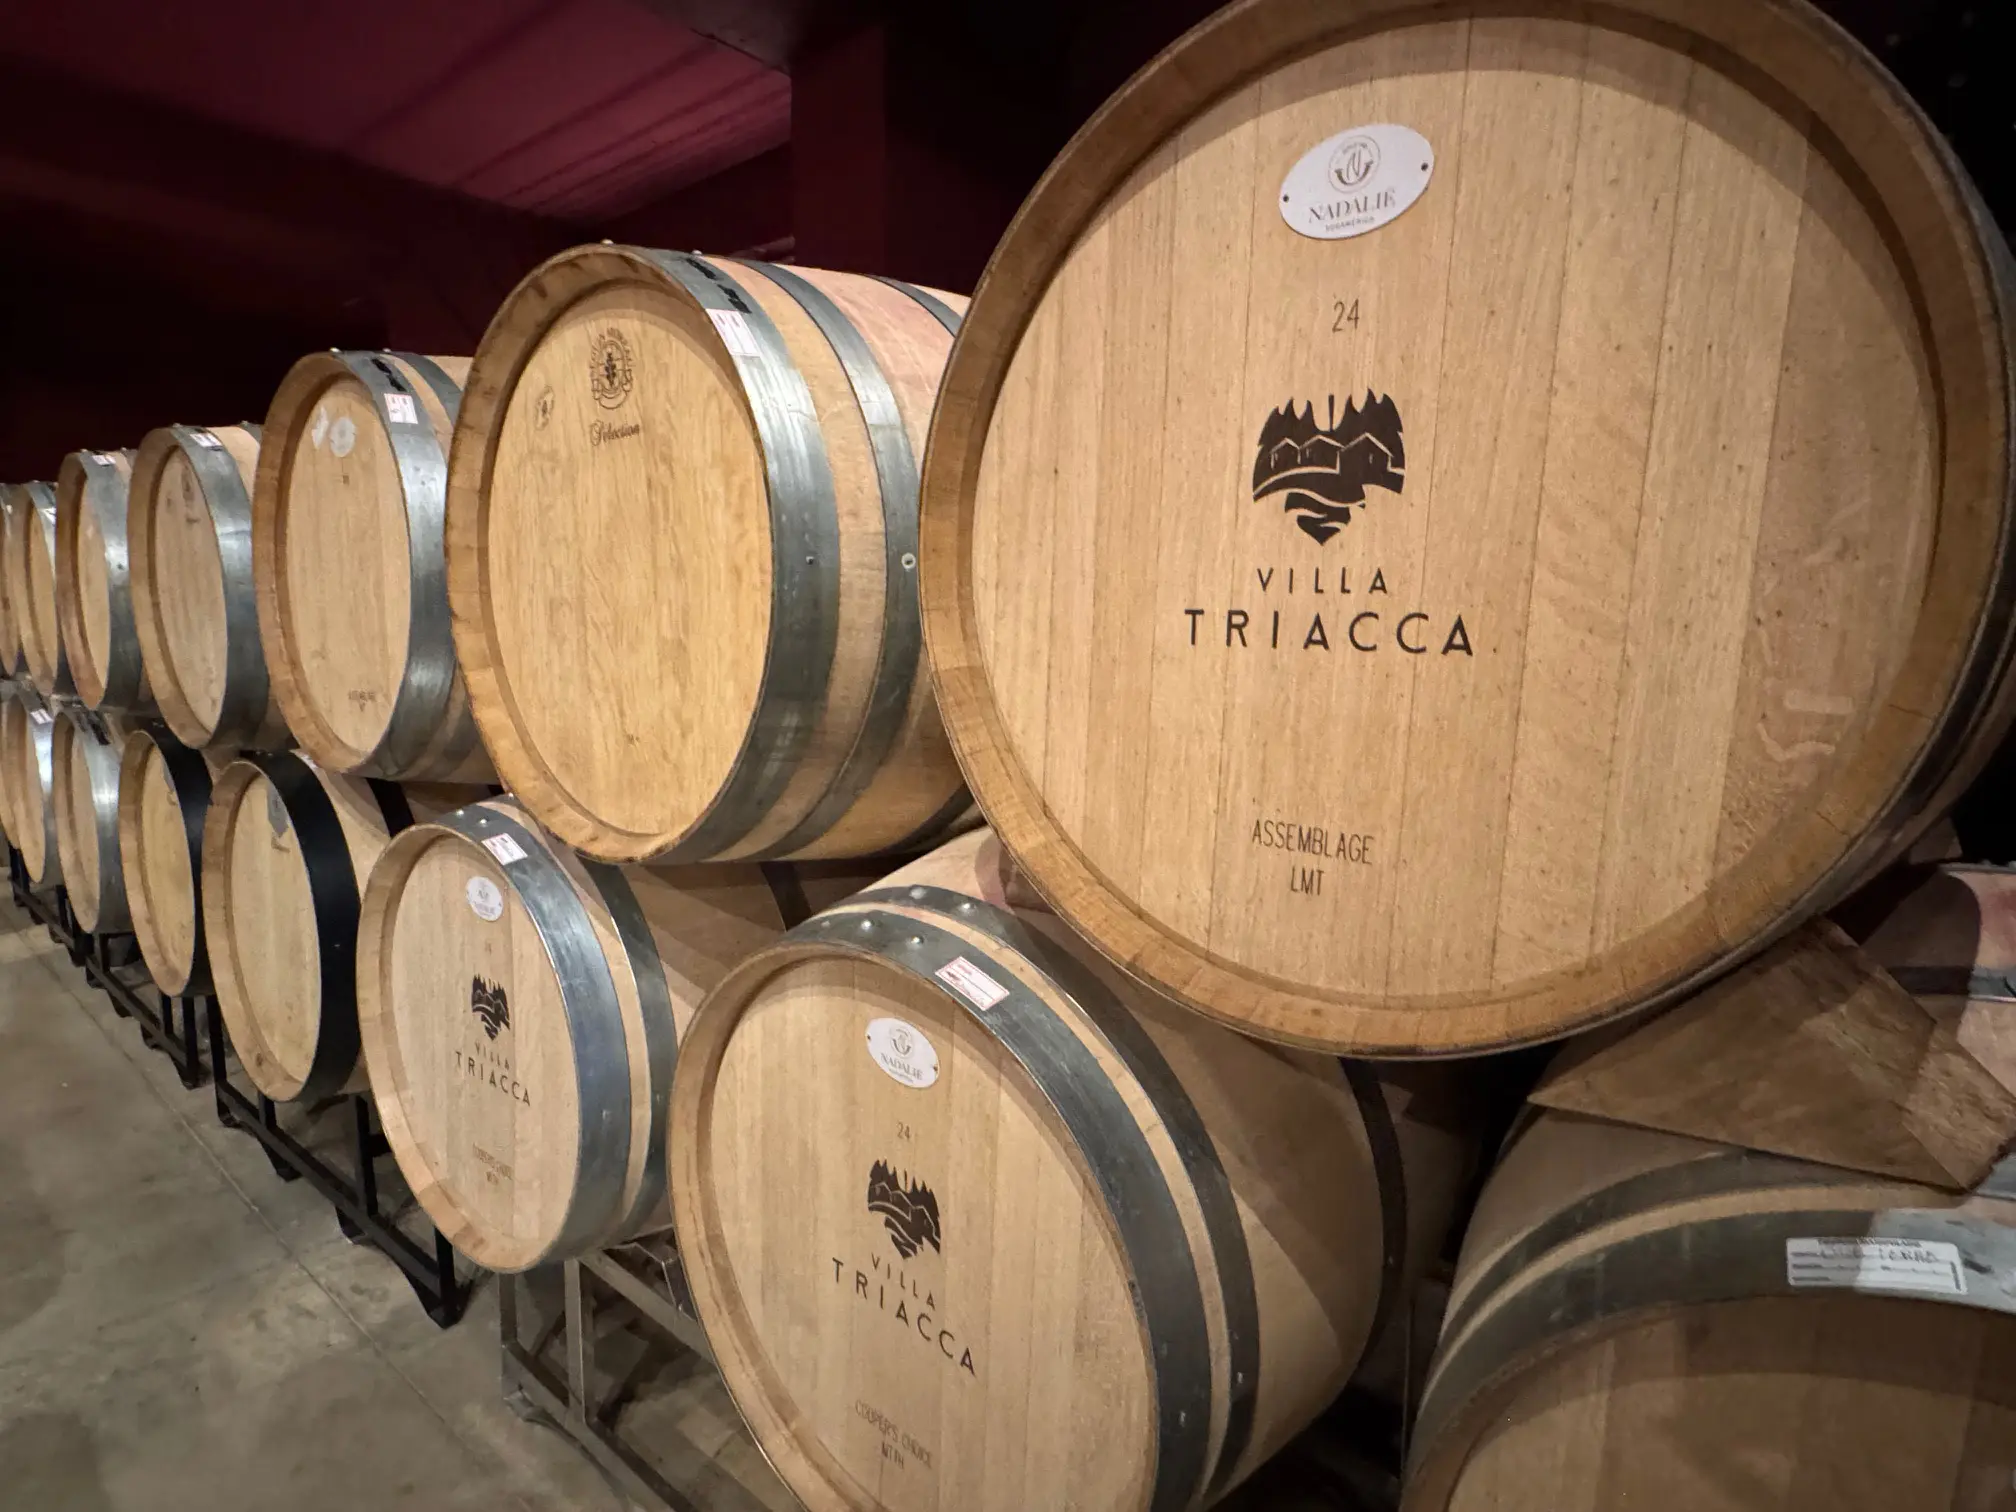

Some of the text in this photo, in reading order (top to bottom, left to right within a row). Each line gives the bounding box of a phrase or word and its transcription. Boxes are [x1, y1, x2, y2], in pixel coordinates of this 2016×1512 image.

[1332, 298, 1360, 333] 24
[1256, 567, 1388, 595] VILLA
[1184, 608, 1474, 657] TRIACCA
[1252, 819, 1376, 865] ASSEMBLAGE
[1290, 866, 1325, 897] LMT
[474, 1040, 510, 1071] VILLA
[455, 1050, 531, 1107] TRIACCA
[896, 1121, 911, 1140] 24
[871, 1252, 936, 1312] VILLA
[832, 1257, 976, 1377] TRIACCA
